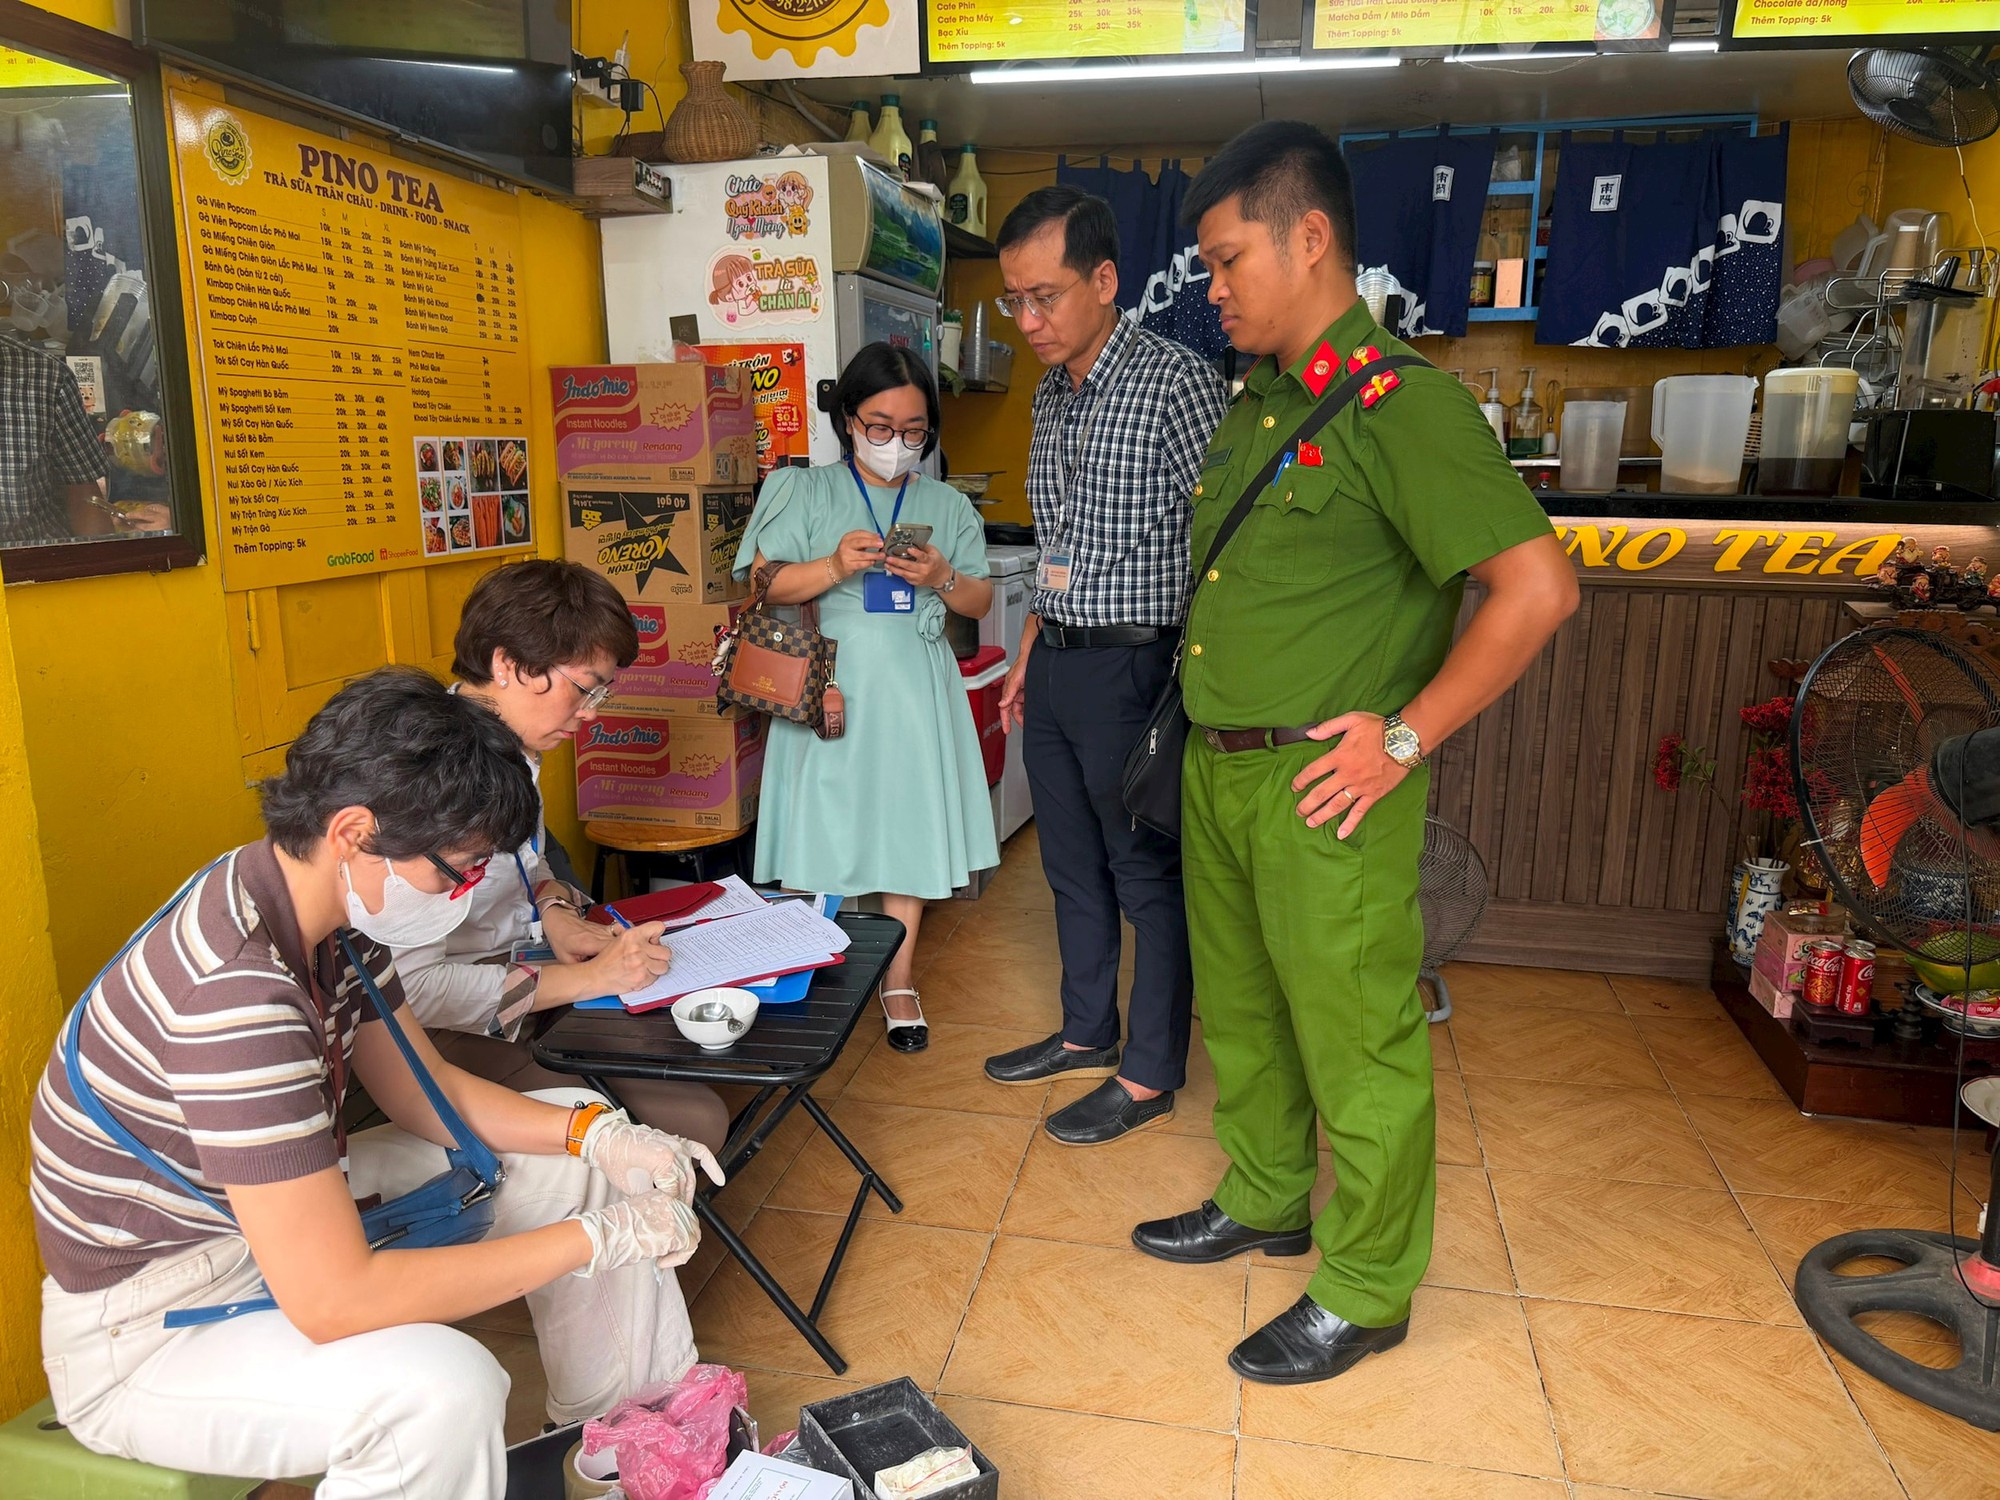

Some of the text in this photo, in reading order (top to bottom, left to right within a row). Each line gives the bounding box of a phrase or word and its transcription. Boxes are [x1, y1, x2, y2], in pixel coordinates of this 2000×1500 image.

[937, 2, 976, 11] Cafe Phin
[1328, 4, 1589, 21] Matcha Milo 10k 15k 20k 30k
[1754, 0, 1803, 8] Chocolate
[937, 15, 957, 24] Cafe
[960, 15, 975, 23] Pha
[977, 12, 994, 24] Máy
[1068, 10, 1083, 18] 25k
[1127, 8, 1141, 16] 35k
[1751, 15, 1832, 25] Thêm Topping: 5k
[938, 28, 953, 38] Bạc
[955, 26, 969, 37] Xỉu
[1069, 23, 1083, 31] 25k
[1127, 21, 1141, 29] 35k
[1327, 27, 1401, 38] Thêm Topping: 5k
[938, 40, 1006, 50] Thêm Topping: 5k
[298, 143, 379, 194] PINO
[387, 169, 444, 213] TEA
[725, 174, 763, 197] Chúc
[263, 171, 471, 234] TRÀ SỮA TRÂN CHÂU DRINK FOOD SNACK
[725, 200, 784, 218] Quý Khách
[197, 195, 391, 244] Gà Viên Popcorn 10k 15k 20k 25k
[726, 218, 786, 240] Ngon Miệng
[754, 257, 817, 279] TRÀ SỮA
[206, 278, 290, 298] Kimbap Chiên Hàn Quốc
[779, 279, 793, 290] là
[759, 290, 812, 311] CHÂN ÁI
[558, 375, 630, 407] Indomie
[220, 403, 229, 413] Mỳ
[231, 404, 263, 415] Spaghetti
[265, 404, 275, 413] Sốt
[566, 419, 627, 429] Instant Noodles
[572, 437, 682, 452] Mi goreng Rendang
[657, 496, 685, 508] 40 gói
[234, 539, 306, 554] Thêm Topping: 5k
[598, 535, 670, 565] KORENO
[1554, 524, 1902, 576] NO TEA
[327, 550, 374, 567] GrabFood
[607, 559, 650, 576] MÌ TRỘN
[618, 671, 709, 688] goreng Rendang
[581, 722, 663, 749] Indomie
[590, 762, 656, 774] Instant Noodles
[594, 779, 709, 799] Mi goreng Rendang
